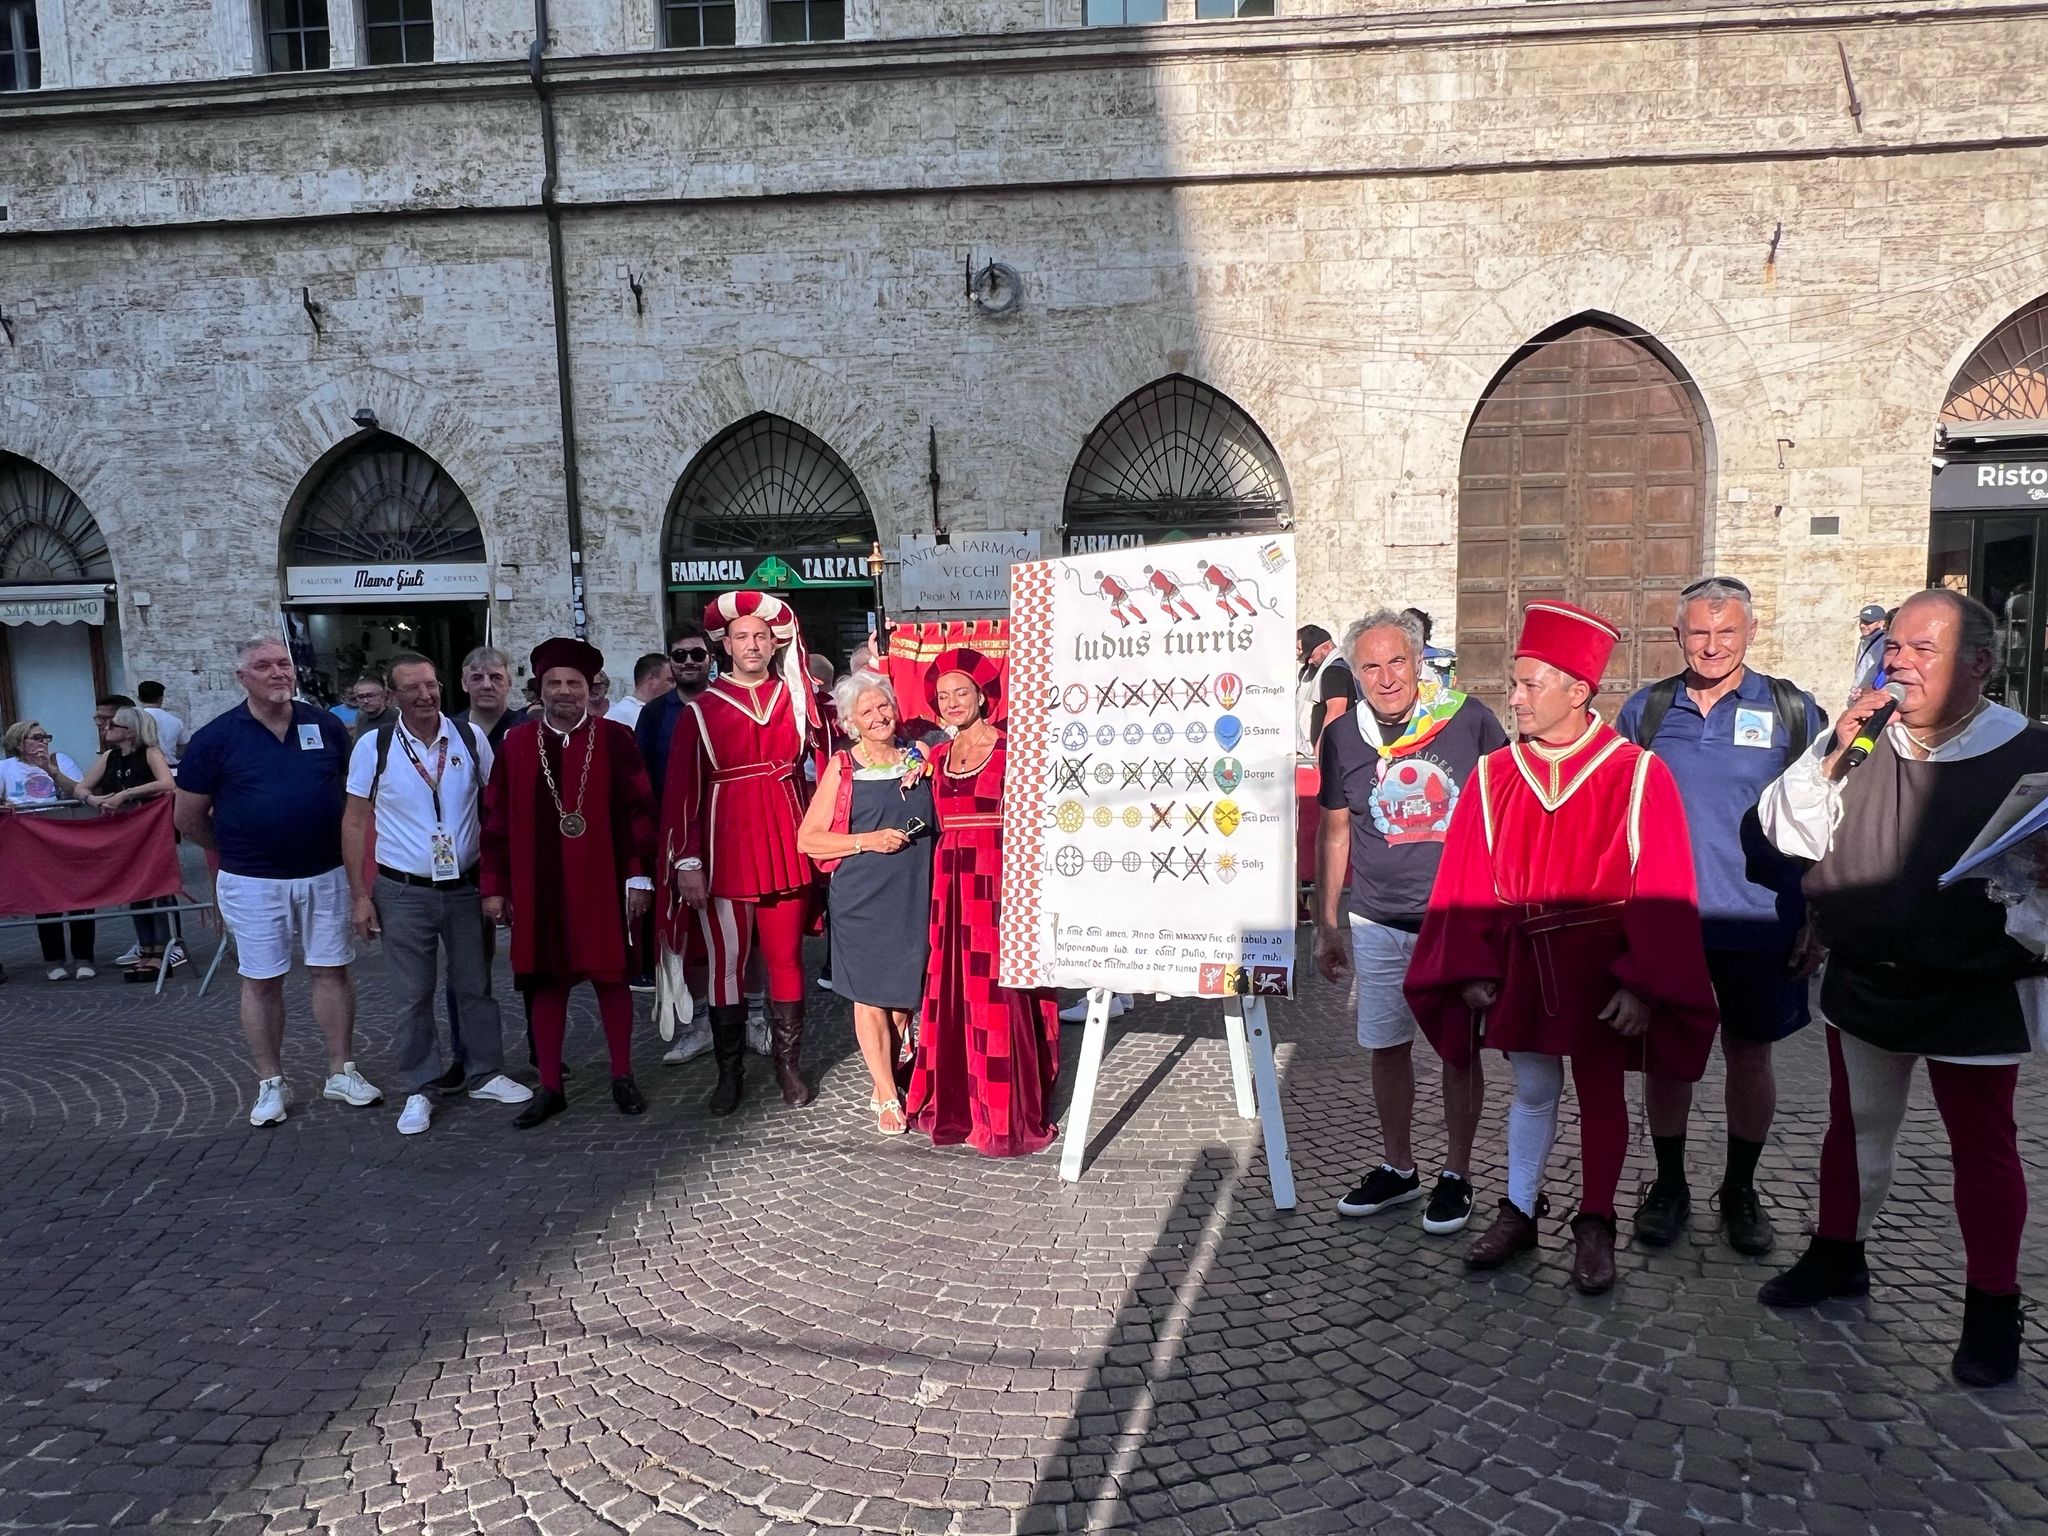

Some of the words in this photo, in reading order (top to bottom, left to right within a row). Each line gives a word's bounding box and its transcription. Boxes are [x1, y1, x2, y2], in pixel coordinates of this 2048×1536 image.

[1977, 464, 2048, 488] Risto
[902, 543, 957, 570] ANTICA
[962, 539, 1040, 562] FARMACIA
[1070, 533, 1145, 556] FARMACIA
[354, 569, 394, 588] Mauro
[671, 560, 745, 582] FARMACIA
[943, 565, 999, 578] VECCHI
[968, 589, 1009, 601] TARPA
[4, 604, 31, 617] SAN
[33, 601, 98, 616] MARTINO
[1074, 630, 1151, 662] ludus
[1163, 621, 1254, 656] turris
[1047, 685, 1061, 709] 2
[1050, 728, 1060, 743] 5
[1415, 750, 1454, 777] RIDER
[1043, 805, 1058, 828] 3
[1045, 851, 1053, 876] 4
